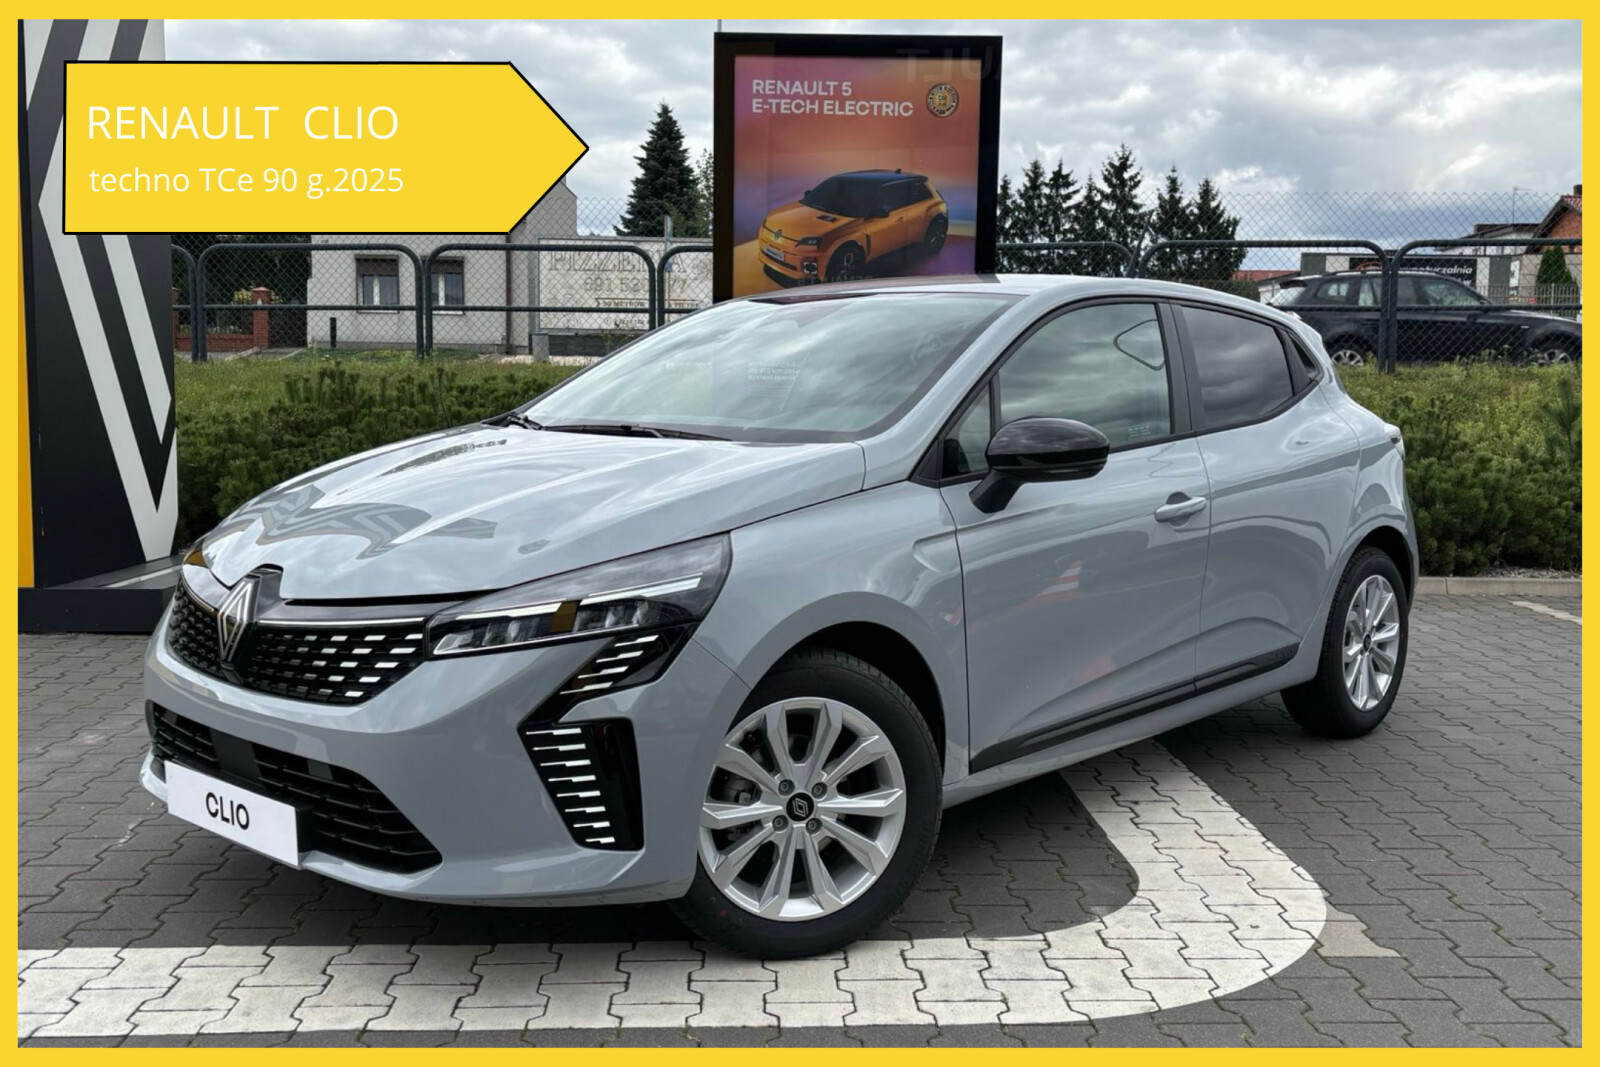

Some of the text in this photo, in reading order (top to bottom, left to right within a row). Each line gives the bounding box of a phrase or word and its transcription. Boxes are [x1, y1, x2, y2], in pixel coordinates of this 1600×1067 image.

[752, 79, 852, 97] RENAULT 5
[752, 98, 819, 114] E-TECH
[823, 100, 914, 117] ELECTRIC
[548, 246, 687, 273] PIZZEA
[206, 792, 250, 830] CLIO
